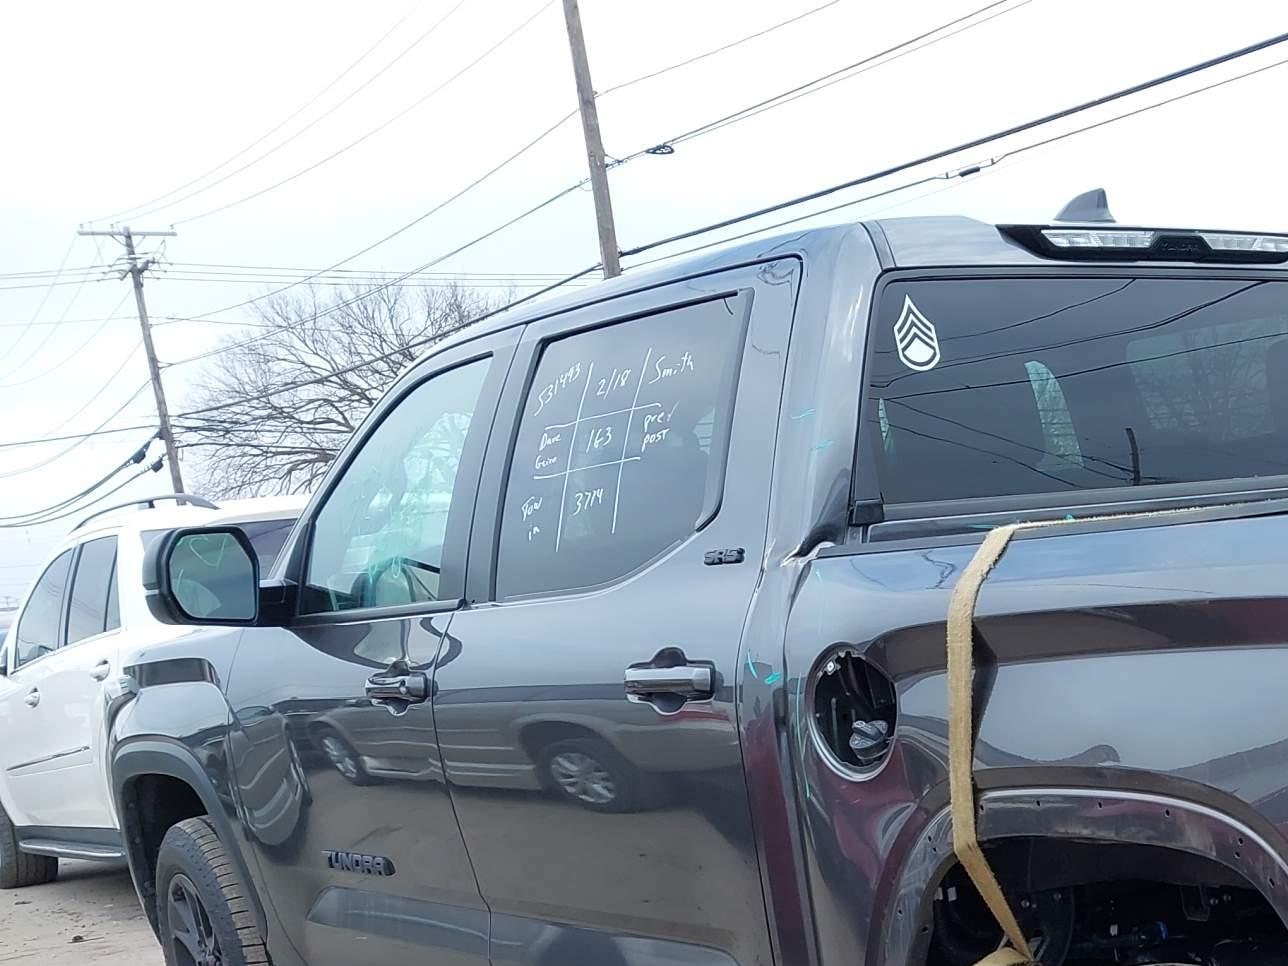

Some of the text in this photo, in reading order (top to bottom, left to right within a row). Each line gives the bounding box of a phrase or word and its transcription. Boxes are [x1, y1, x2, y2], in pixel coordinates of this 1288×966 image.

[648, 351, 694, 385] Smith
[596, 368, 632, 400] 2/18
[585, 426, 612, 453] 163
[320, 849, 396, 876] TUNDRA
